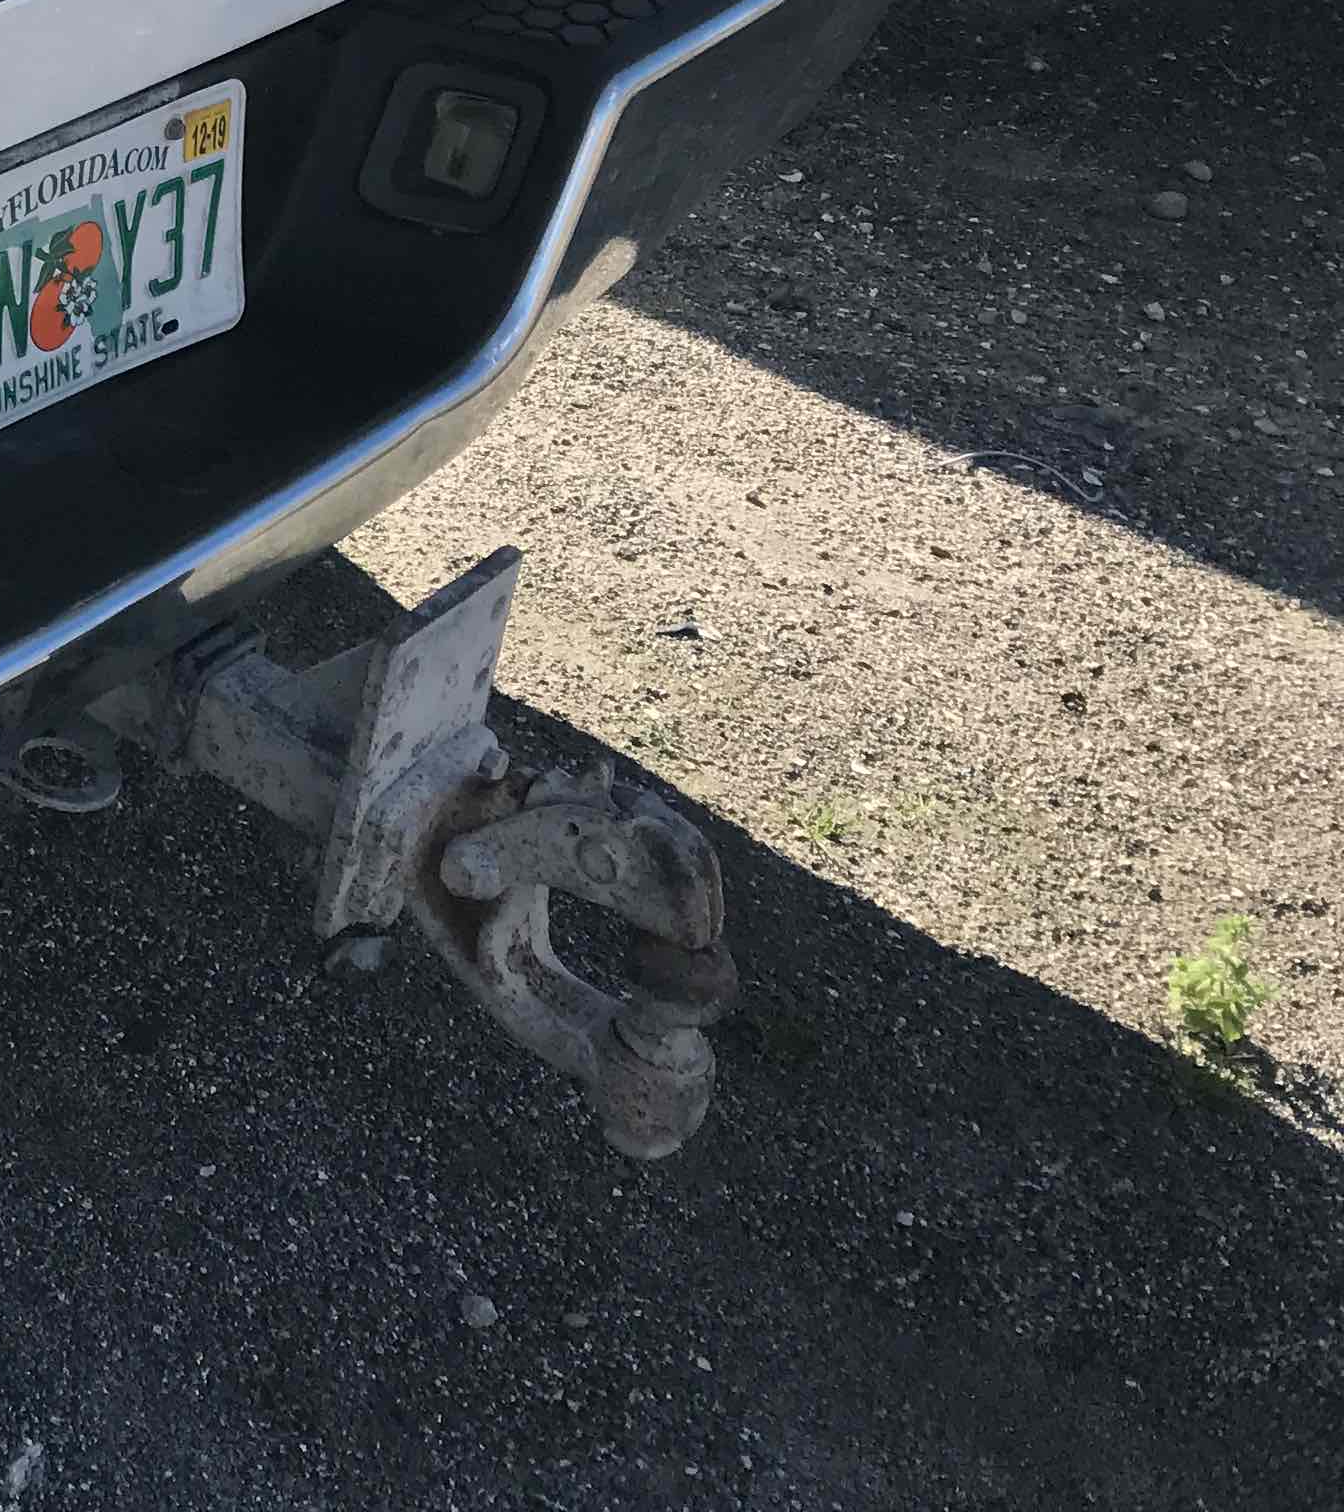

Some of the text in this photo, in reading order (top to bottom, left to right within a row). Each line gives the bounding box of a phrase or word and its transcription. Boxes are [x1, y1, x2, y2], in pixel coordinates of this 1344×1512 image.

[192, 115, 227, 157] 12-19
[113, 158, 225, 311] Y37
[92, 306, 165, 369] STATE
